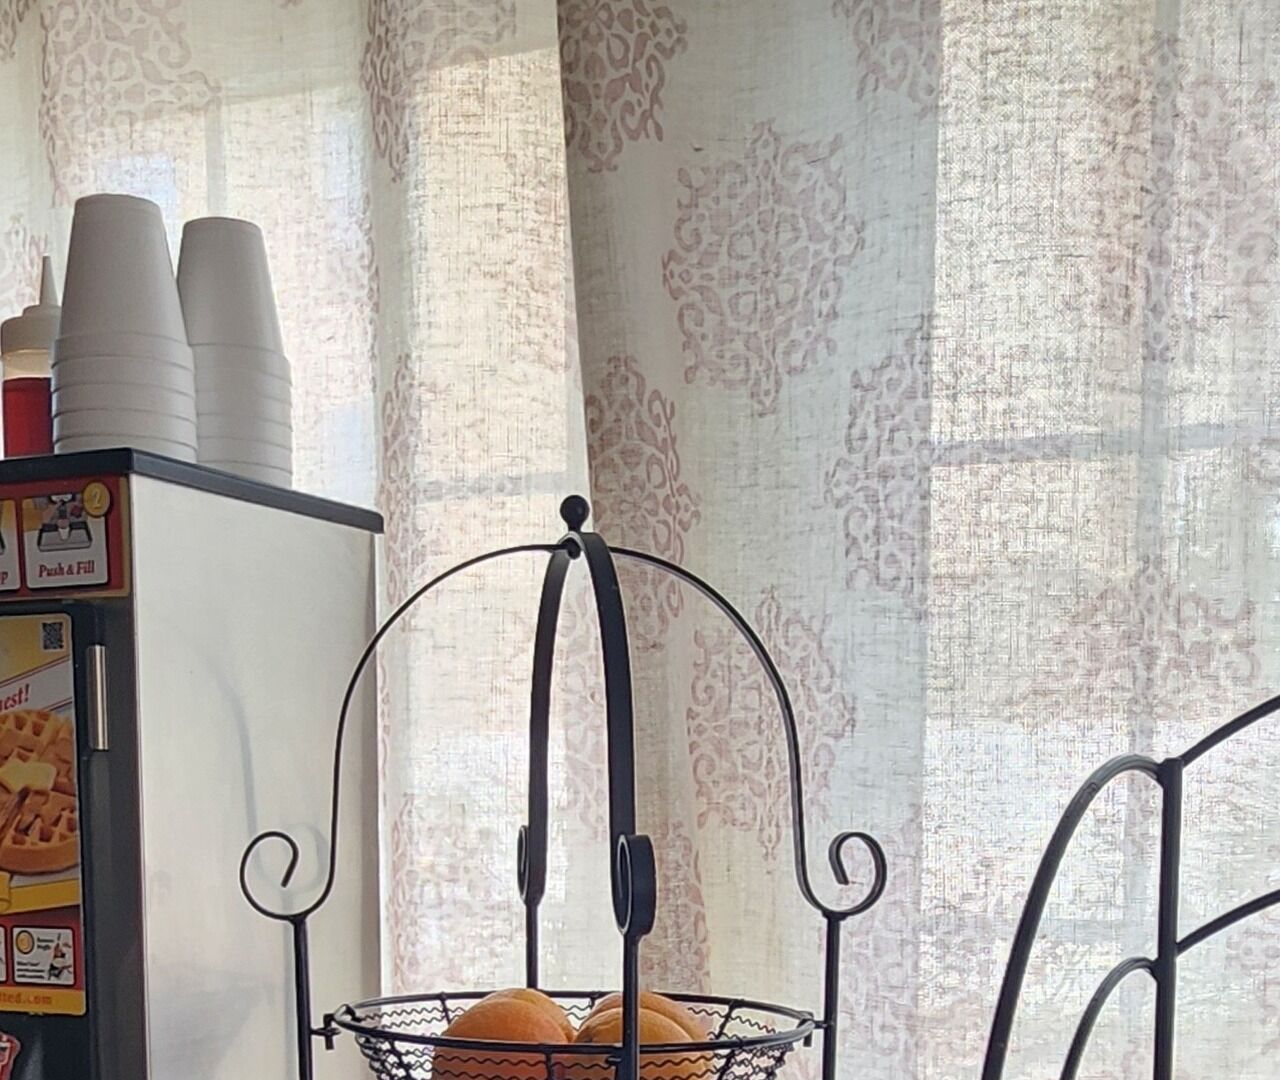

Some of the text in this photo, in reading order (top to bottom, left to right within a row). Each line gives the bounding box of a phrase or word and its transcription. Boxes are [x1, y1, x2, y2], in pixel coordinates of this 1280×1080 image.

[38, 560, 96, 579] Push & Fill
